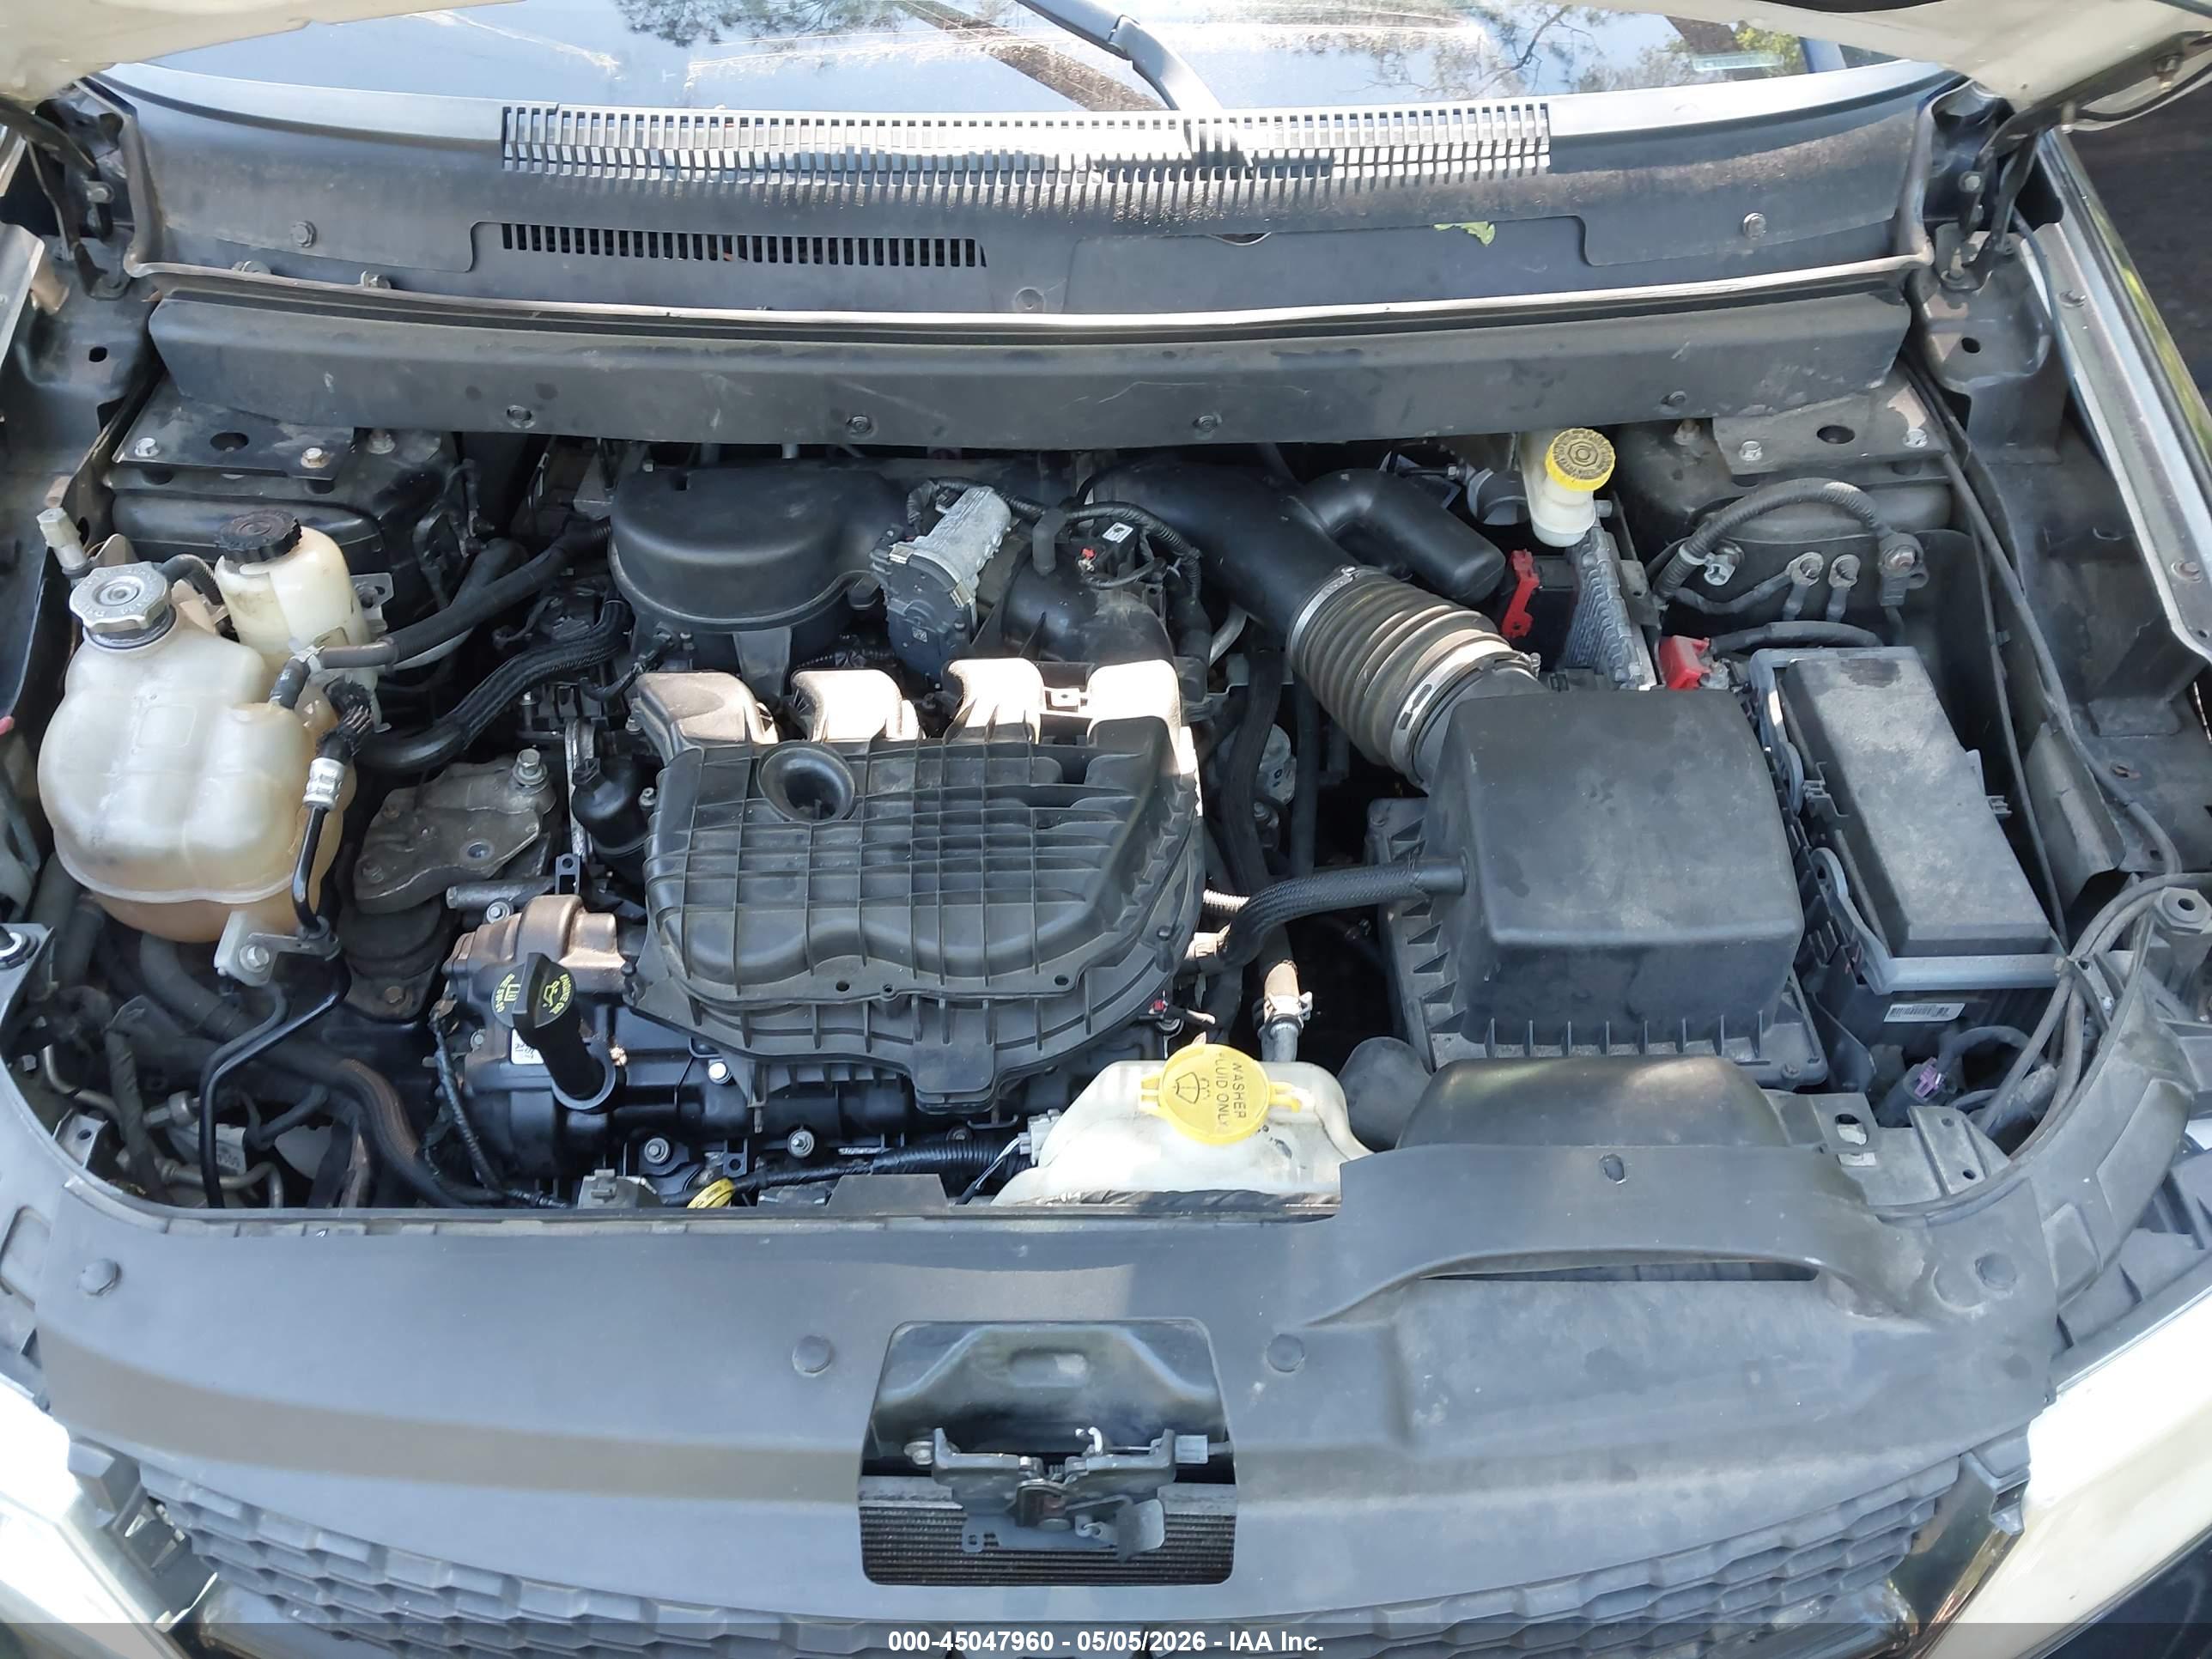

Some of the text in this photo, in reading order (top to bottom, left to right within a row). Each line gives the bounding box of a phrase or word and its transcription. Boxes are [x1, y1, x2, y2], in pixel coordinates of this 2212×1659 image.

[550, 973, 572, 1015] ENGINE OIL
[1216, 1093, 1230, 1127] ONLY
[1232, 1061, 1247, 1119] WASHER
